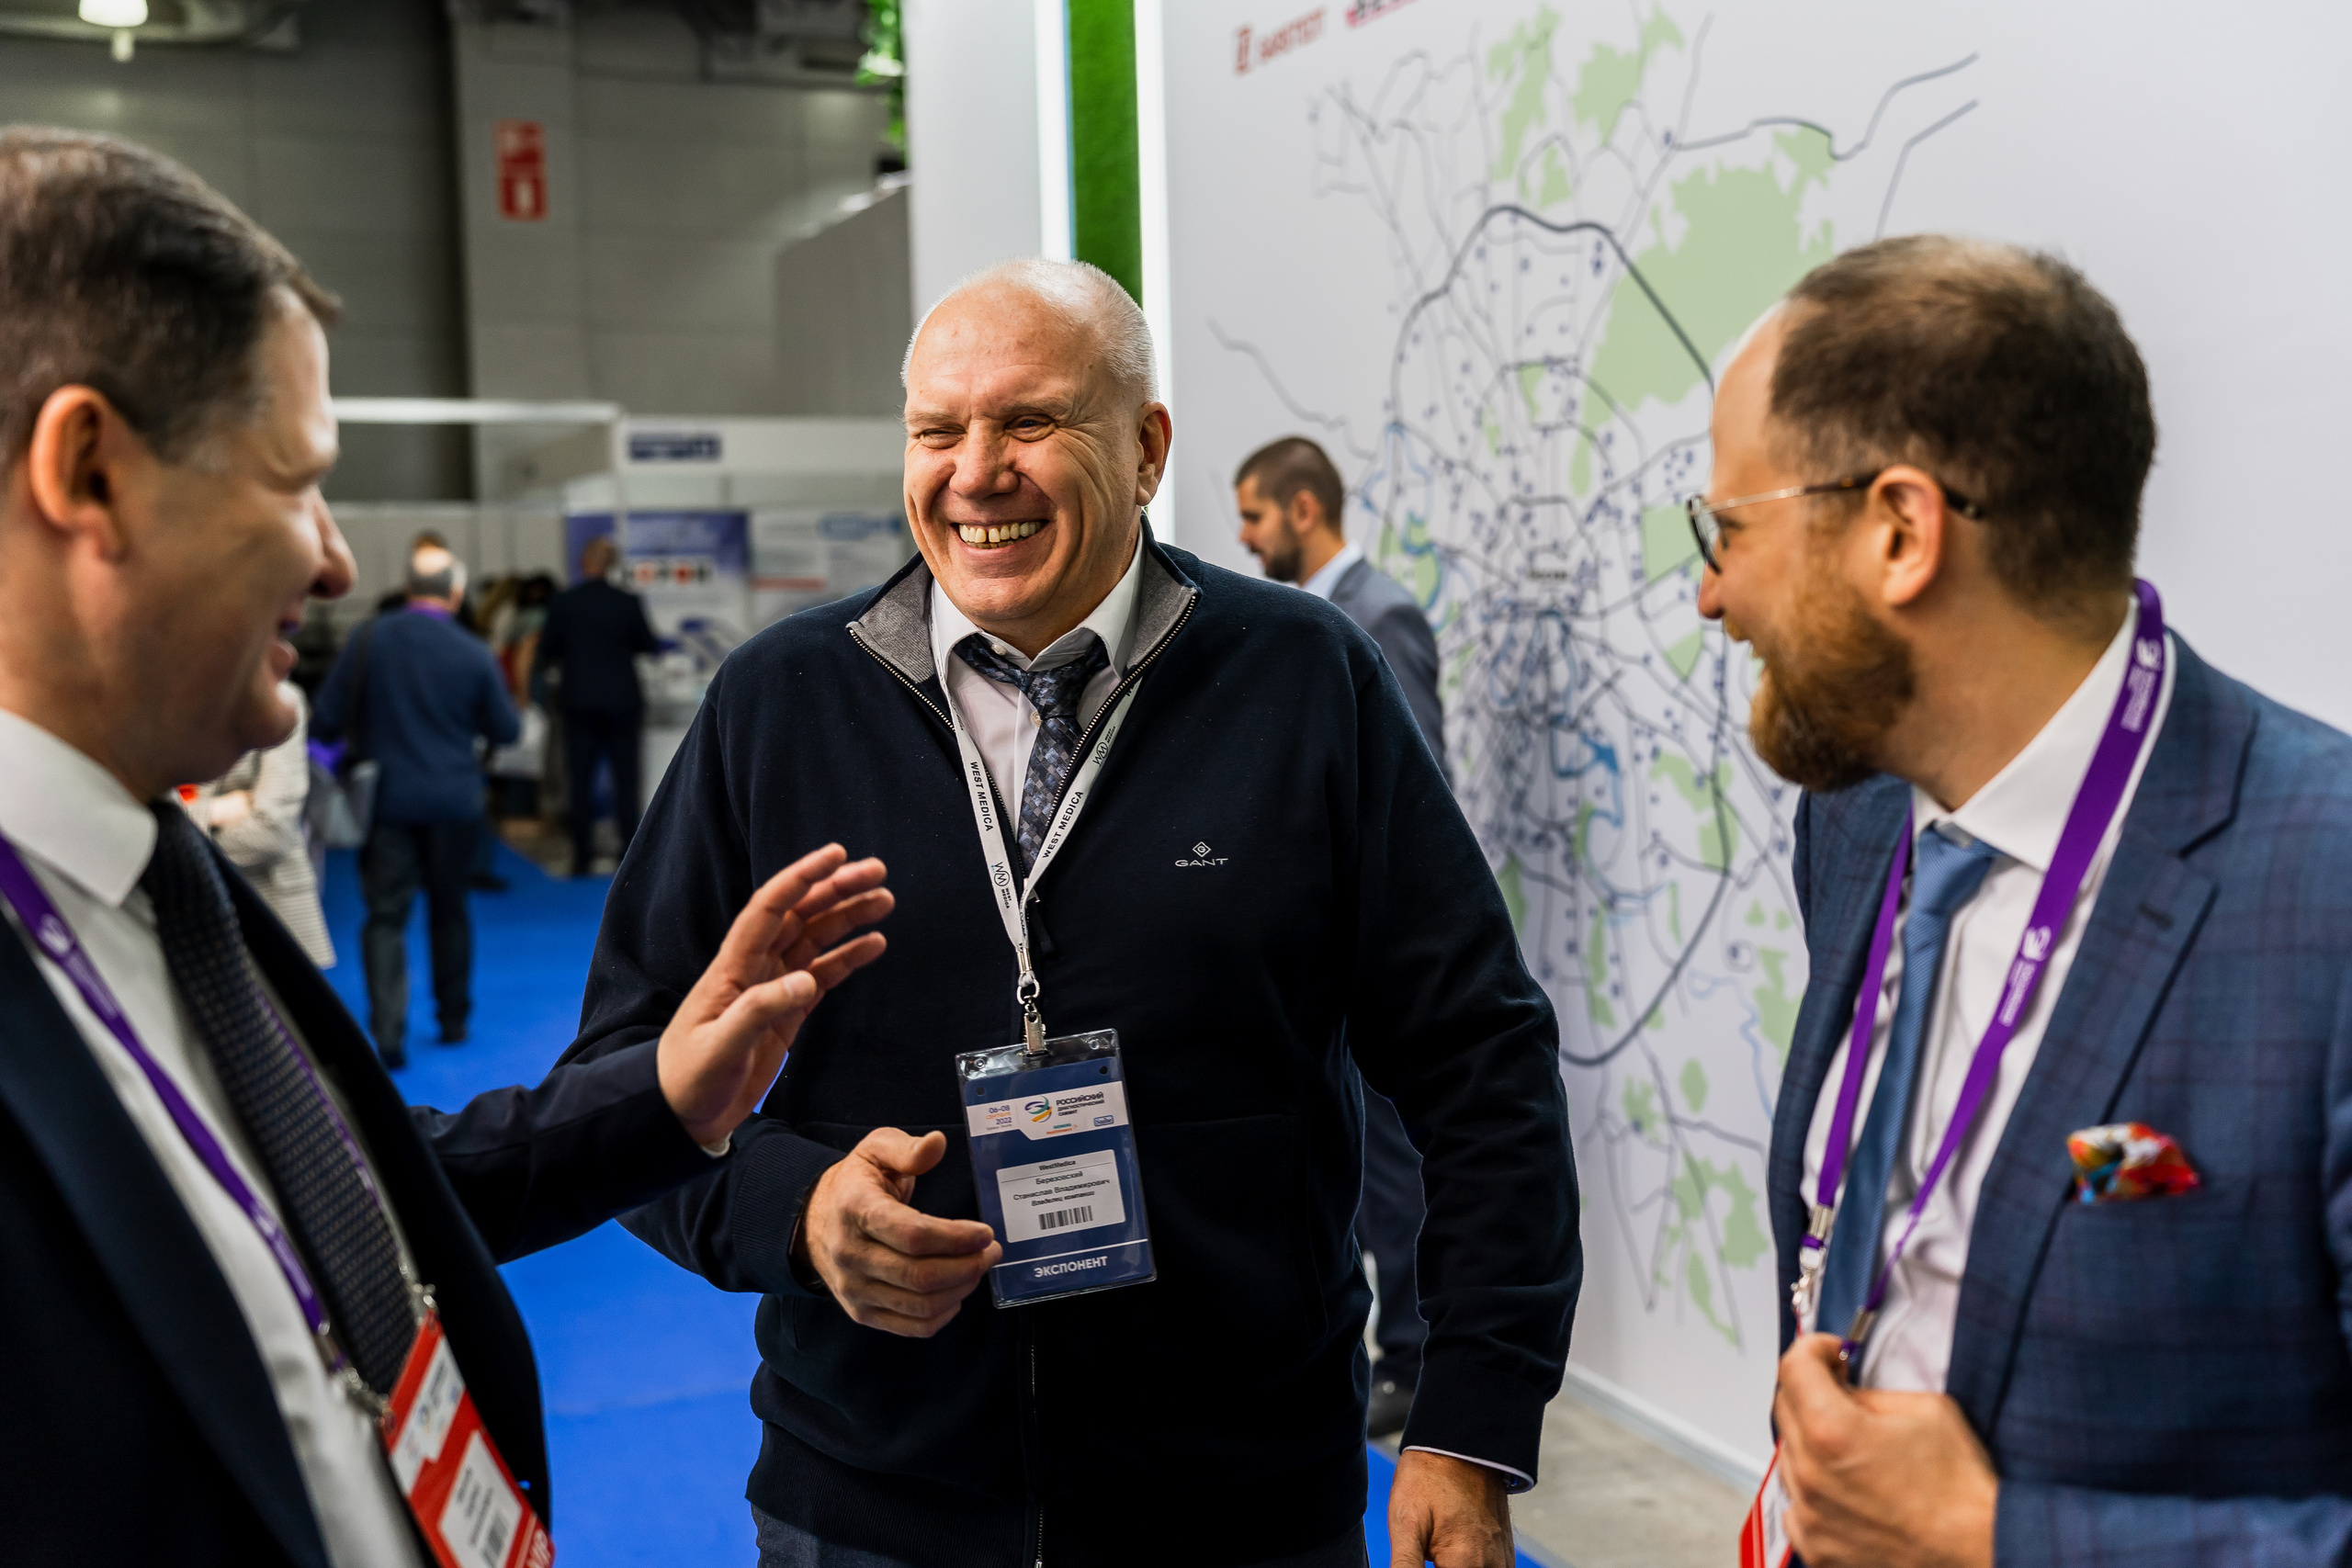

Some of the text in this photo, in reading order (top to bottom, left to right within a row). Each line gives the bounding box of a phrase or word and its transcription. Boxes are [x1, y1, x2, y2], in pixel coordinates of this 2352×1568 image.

[969, 761, 994, 831] WEST MEDICA
[1042, 791, 1084, 859] WEST MEDICA
[1174, 858, 1229, 867] GANT
[1001, 888, 1011, 909] MEDICA
[1056, 1091, 1104, 1106] РОССИЙСКИЙ
[989, 1104, 1011, 1114] 06-08
[995, 1116, 1012, 1125] 2022
[1038, 1160, 1077, 1171] WestMedica
[1012, 1179, 1111, 1201] Станислав Владимирович
[1031, 1196, 1064, 1207] Владелец
[1033, 1256, 1109, 1279] ЭКСПОНЕНТ
